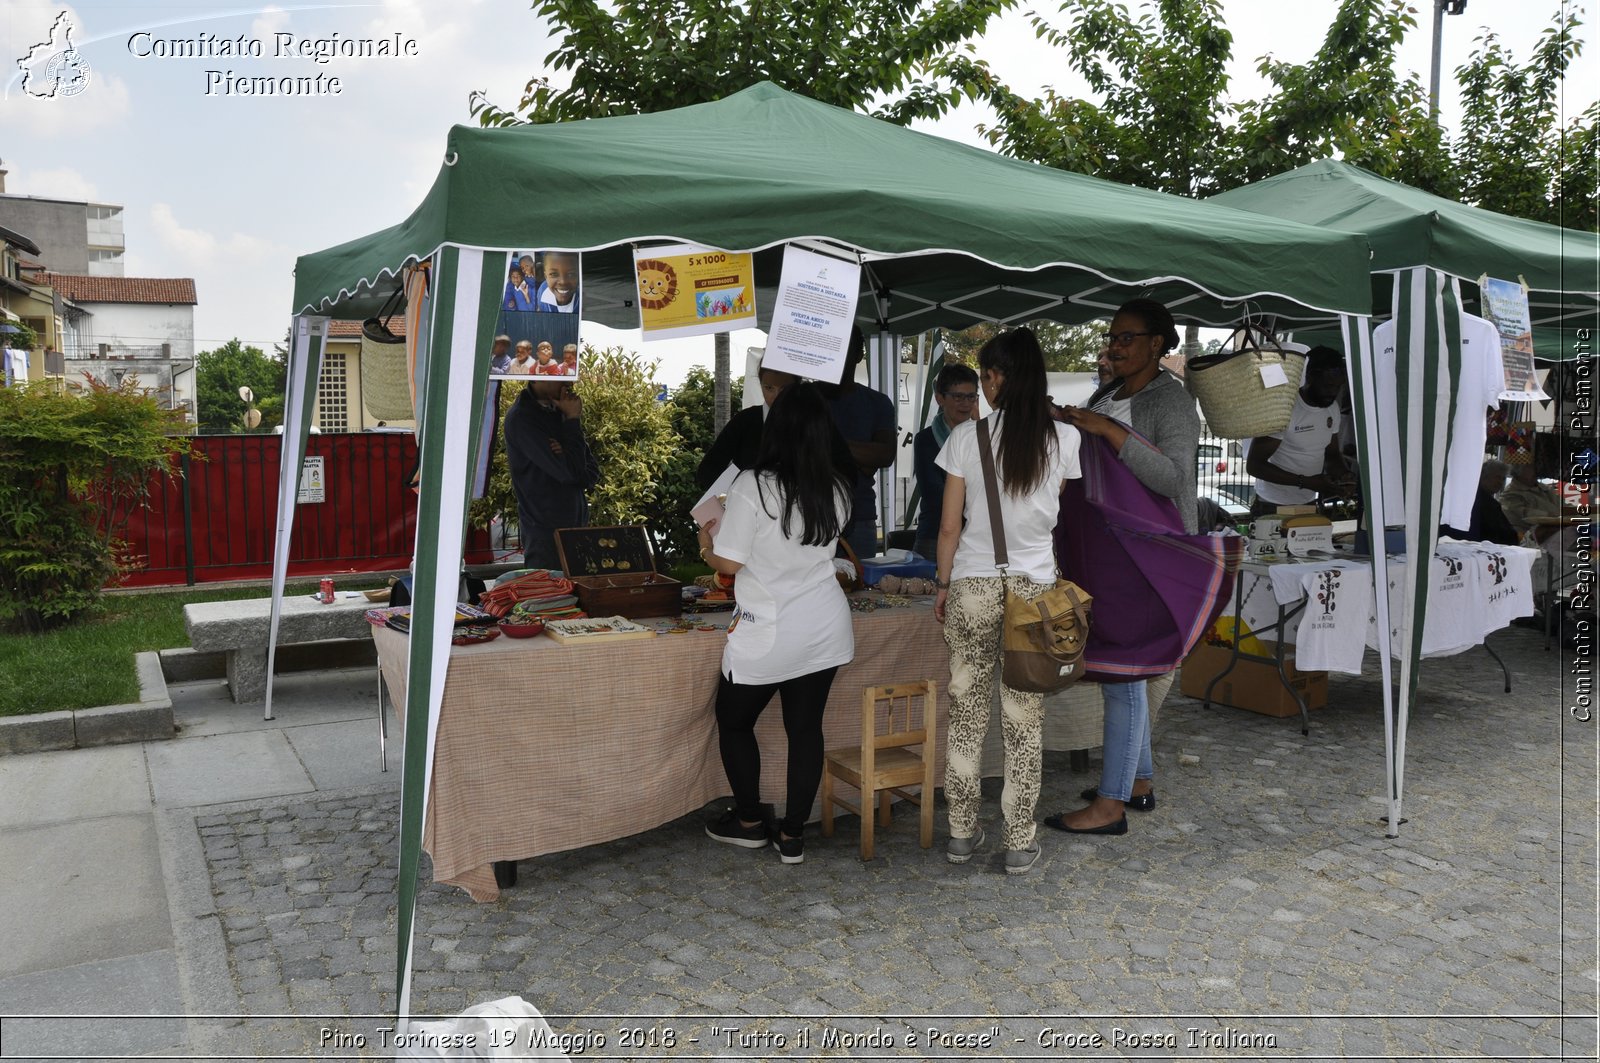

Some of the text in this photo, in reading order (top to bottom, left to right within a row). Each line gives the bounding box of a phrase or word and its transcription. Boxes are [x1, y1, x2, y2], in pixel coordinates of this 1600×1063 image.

[688, 258, 694, 266] 5
[703, 254, 726, 265] 1000
[824, 289, 846, 299] DISTANZA
